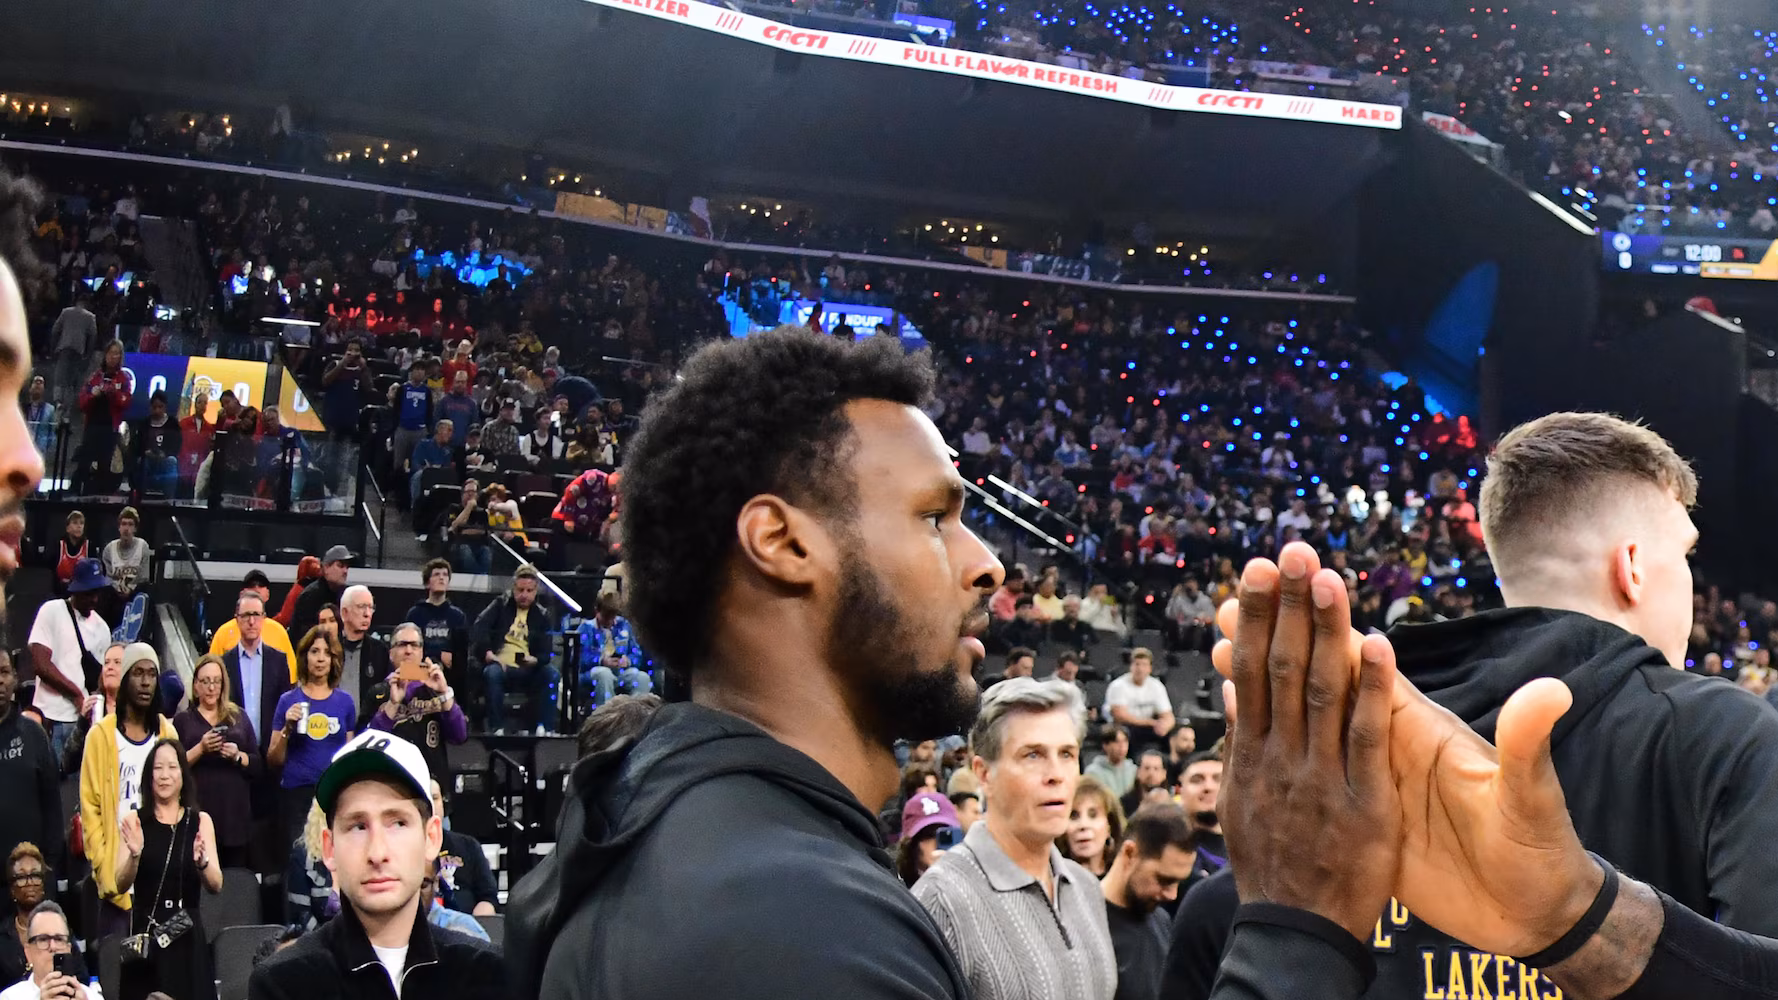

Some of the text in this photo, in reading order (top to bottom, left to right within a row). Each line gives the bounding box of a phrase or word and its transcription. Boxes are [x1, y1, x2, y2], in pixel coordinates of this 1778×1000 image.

[903, 47, 950, 67] FULL
[1034, 66, 1118, 94] REFRESH
[1341, 105, 1396, 123] HARD
[426, 720, 440, 748] 8
